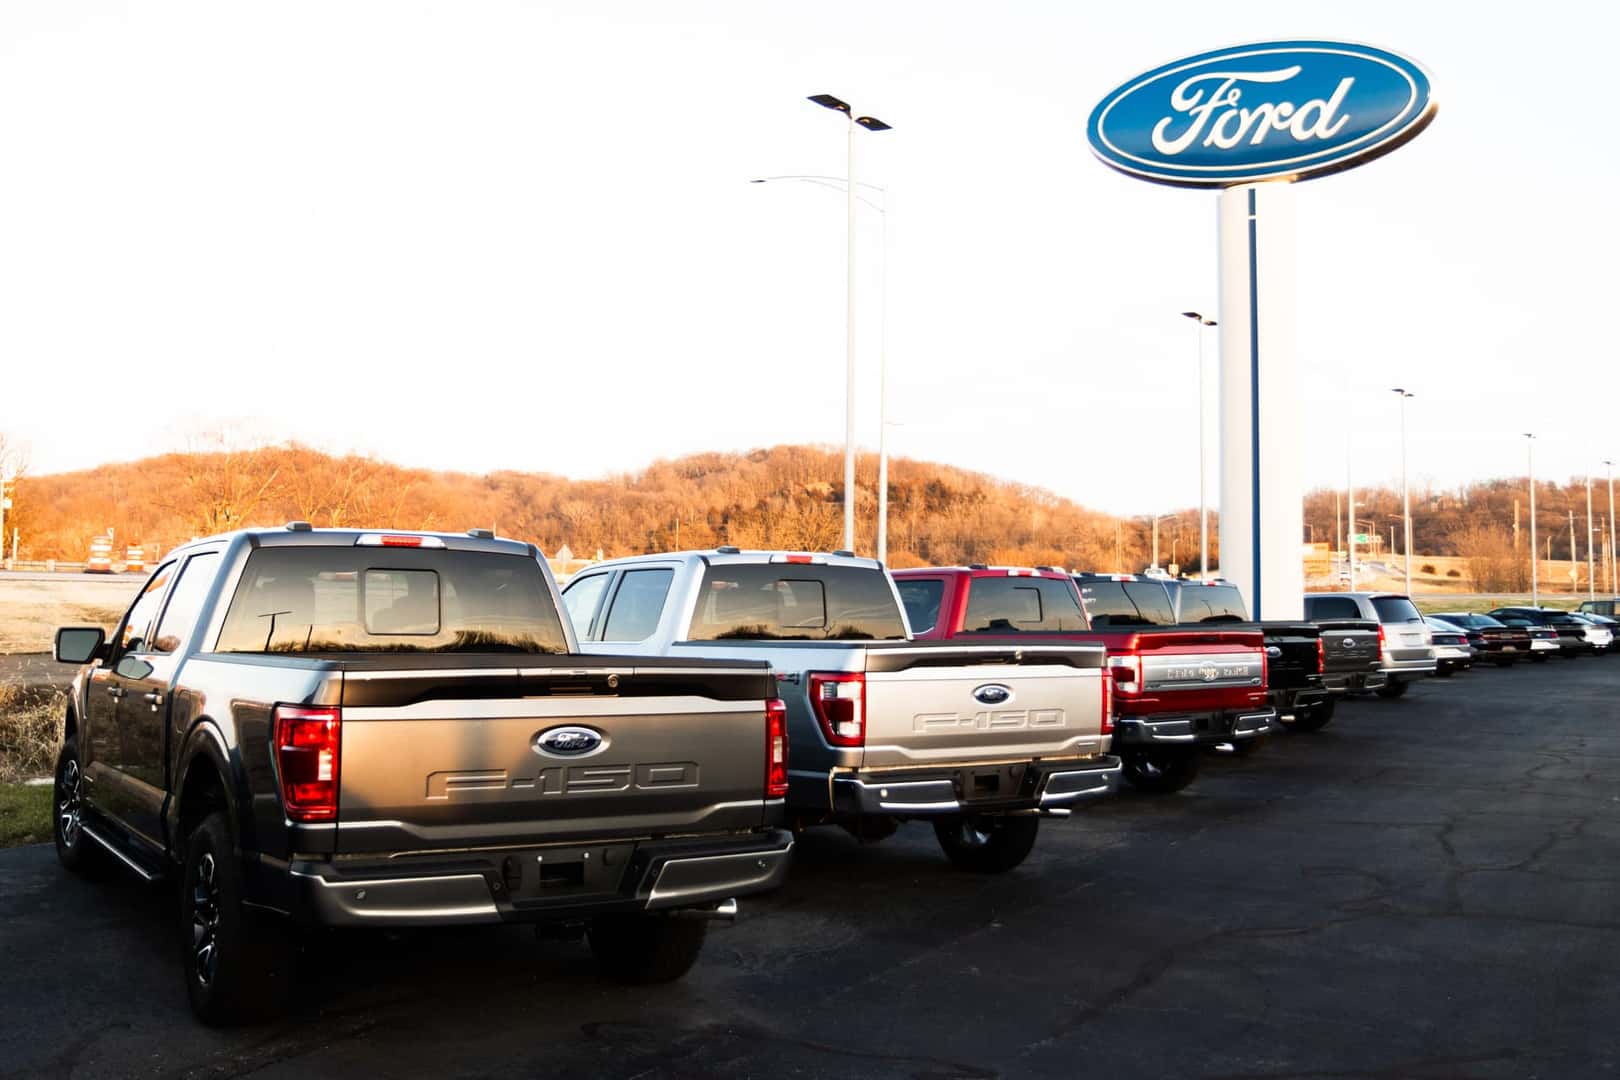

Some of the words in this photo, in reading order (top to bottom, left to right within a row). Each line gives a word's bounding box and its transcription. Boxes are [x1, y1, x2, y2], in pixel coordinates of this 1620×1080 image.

[1151, 65, 1355, 155] Ford
[912, 708, 1066, 734] F-150
[425, 761, 700, 800] F-150
